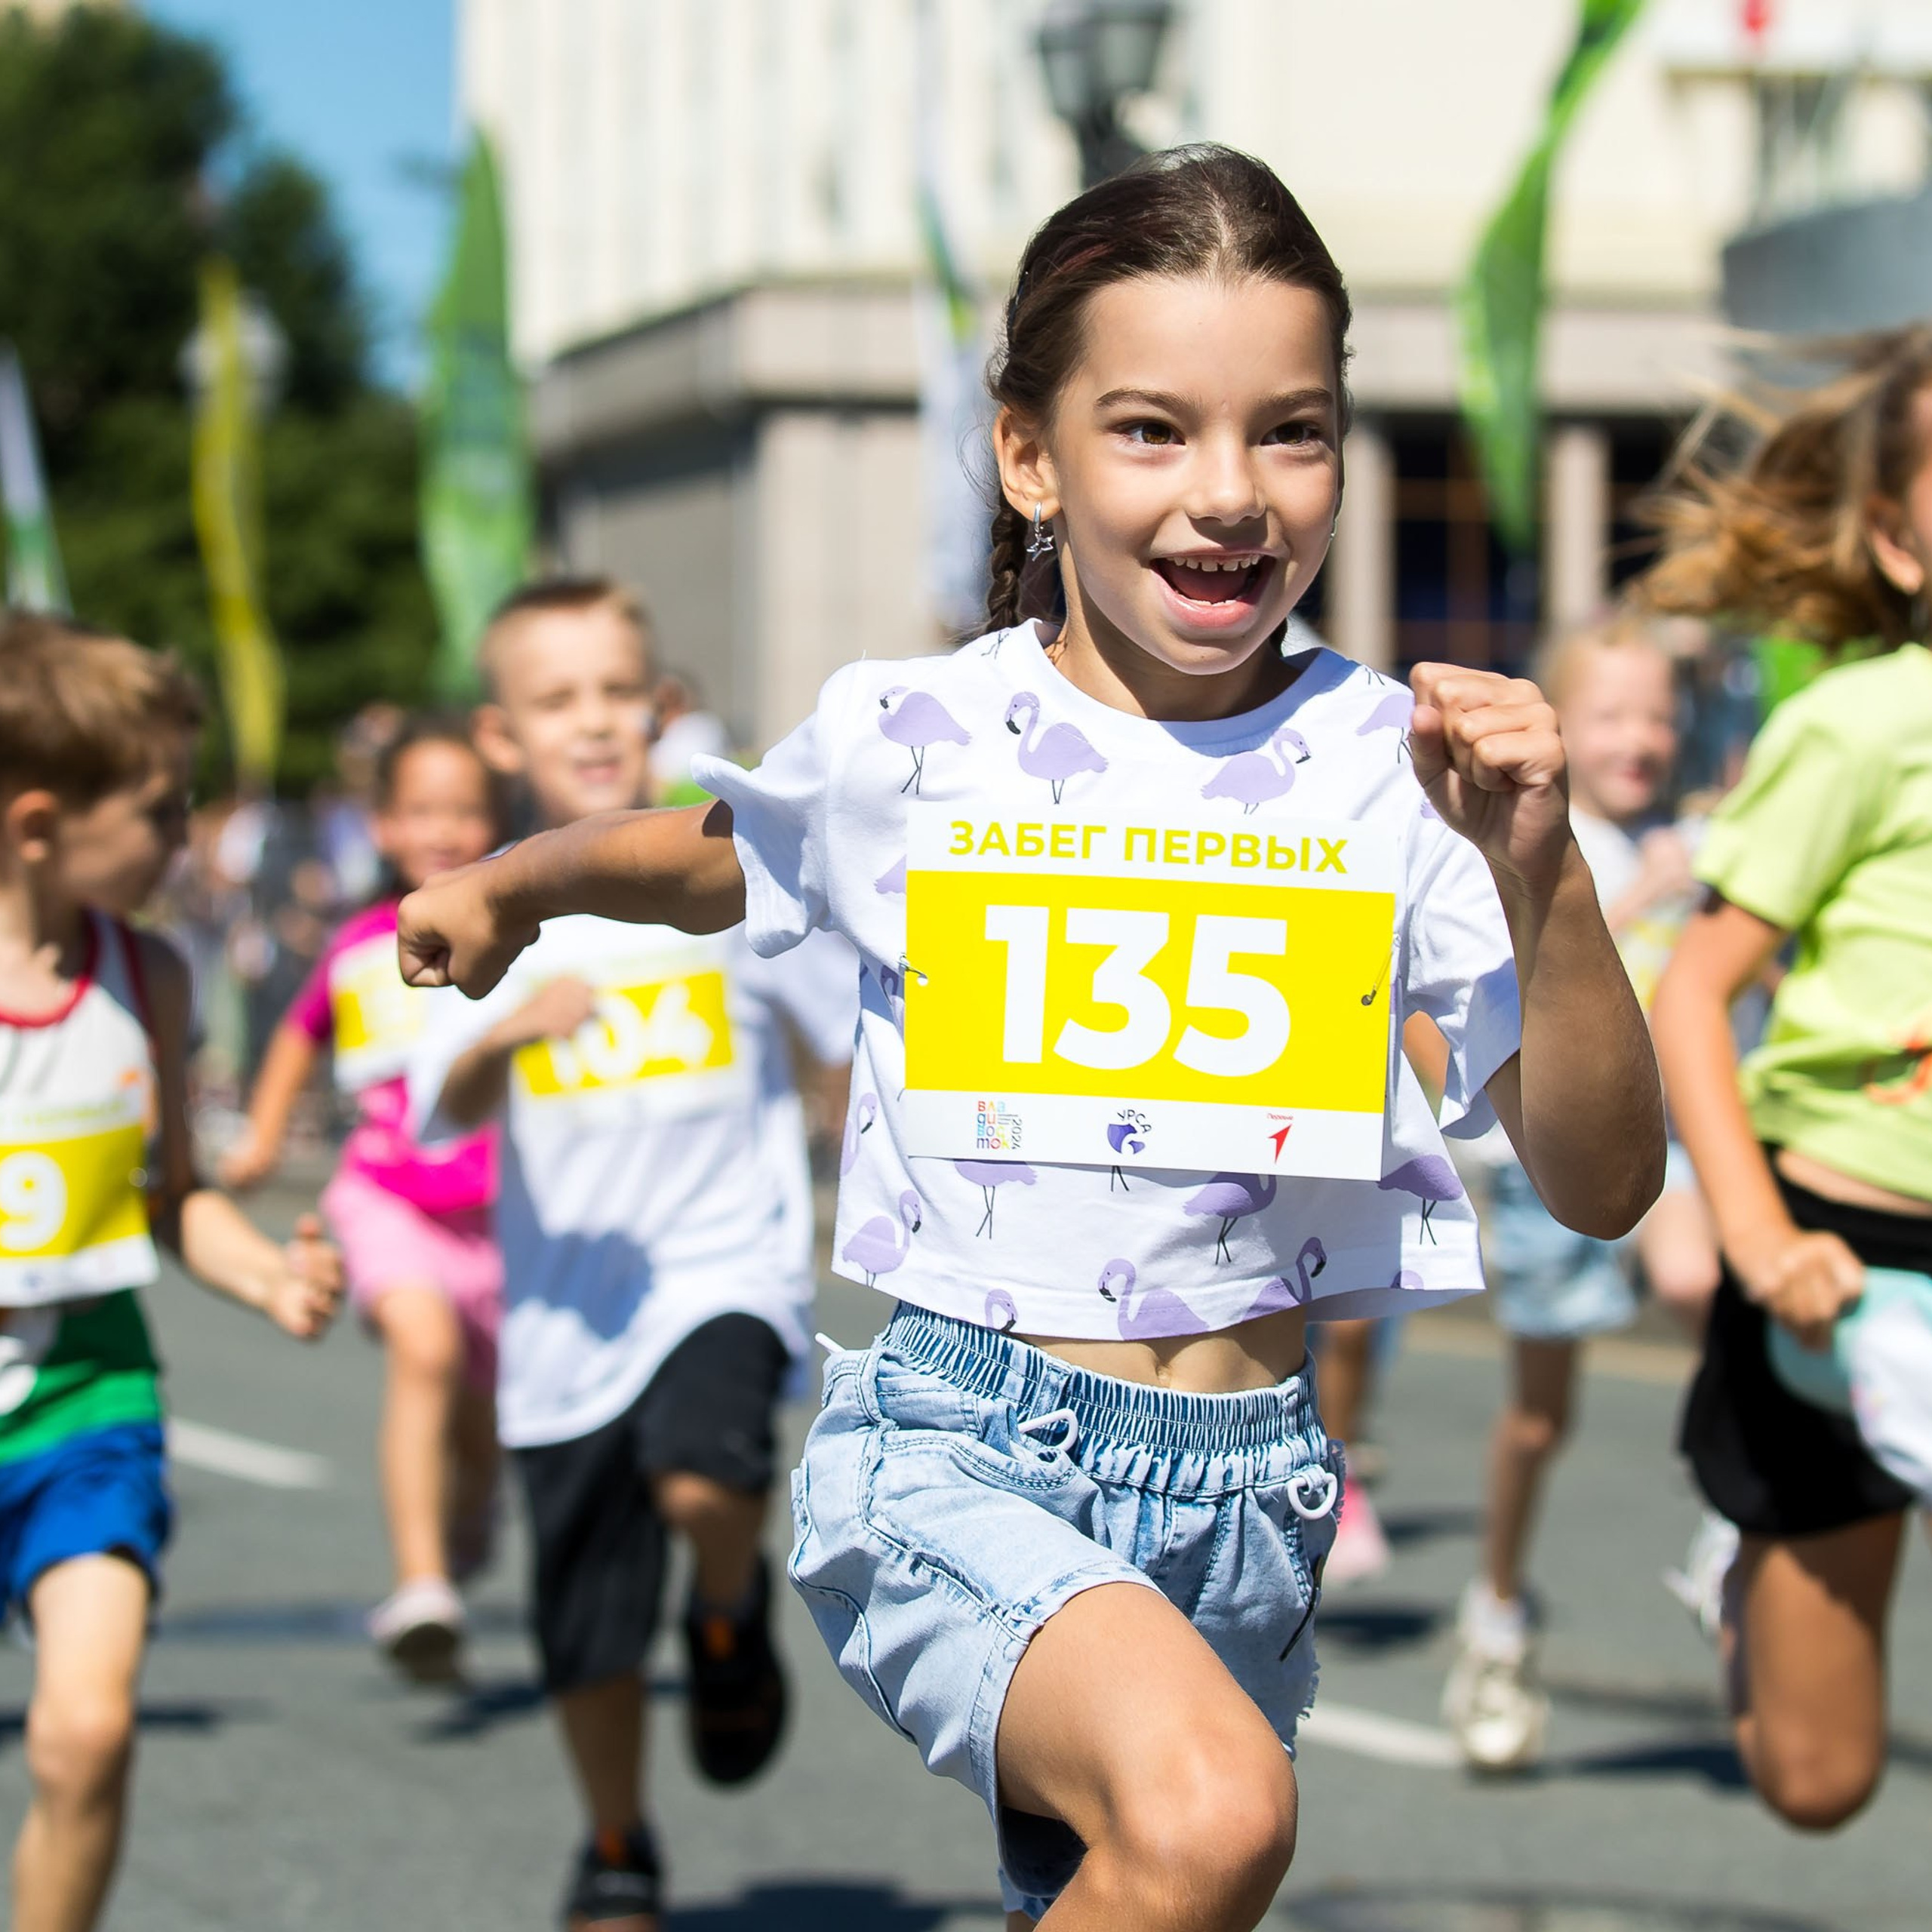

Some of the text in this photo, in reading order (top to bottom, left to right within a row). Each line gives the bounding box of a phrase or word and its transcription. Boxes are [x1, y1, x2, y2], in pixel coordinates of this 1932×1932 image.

[949, 820, 1349, 873] ЗАБЕГ ПЕРВЫХ
[984, 904, 1291, 1077] 135
